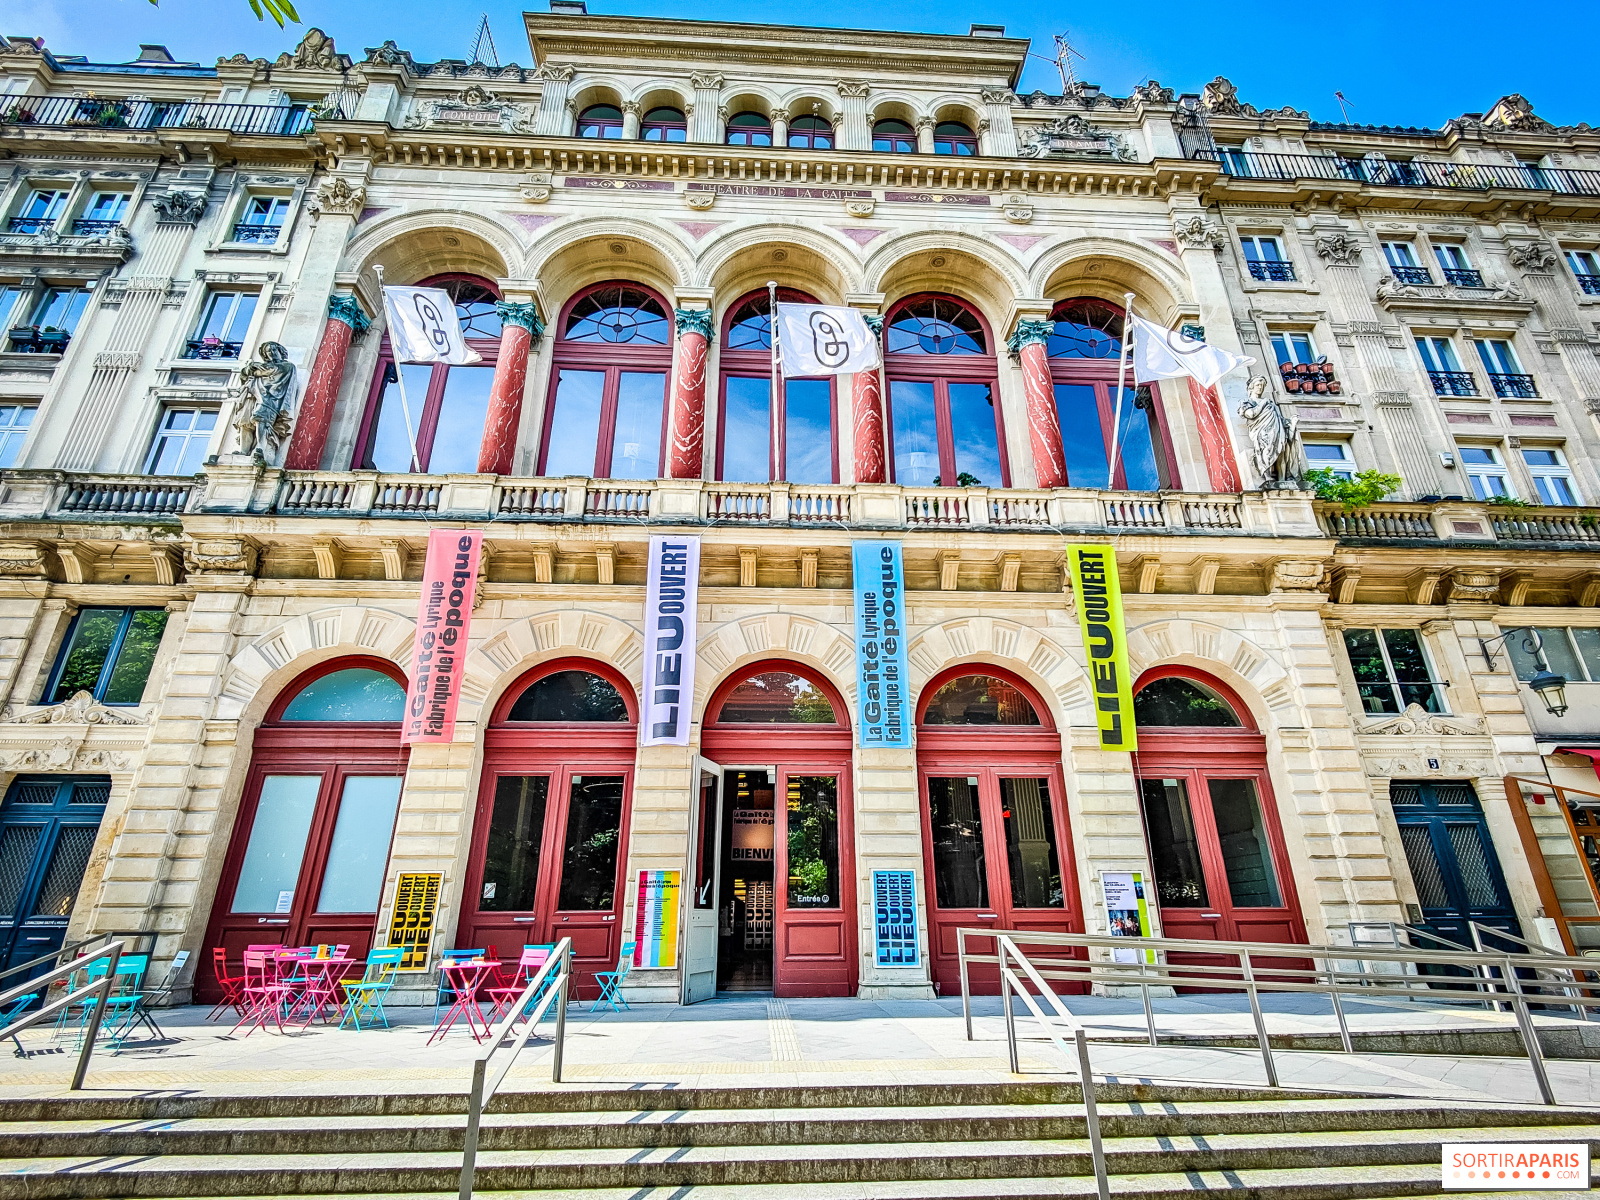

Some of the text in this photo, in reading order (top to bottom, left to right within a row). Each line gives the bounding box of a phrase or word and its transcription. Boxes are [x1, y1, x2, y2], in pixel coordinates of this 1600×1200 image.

[1056, 140, 1101, 149] DRAME
[768, 187, 785, 197] DE
[796, 189, 812, 199] LA
[407, 720, 422, 737] La
[422, 581, 445, 629] Lyrique
[434, 656, 454, 674] de
[861, 591, 883, 742] La Gaîté Lyrique
[882, 665, 899, 681] de
[424, 675, 452, 737] Fabrique
[883, 683, 902, 742] Fabrique
[797, 894, 821, 903] Entrée
